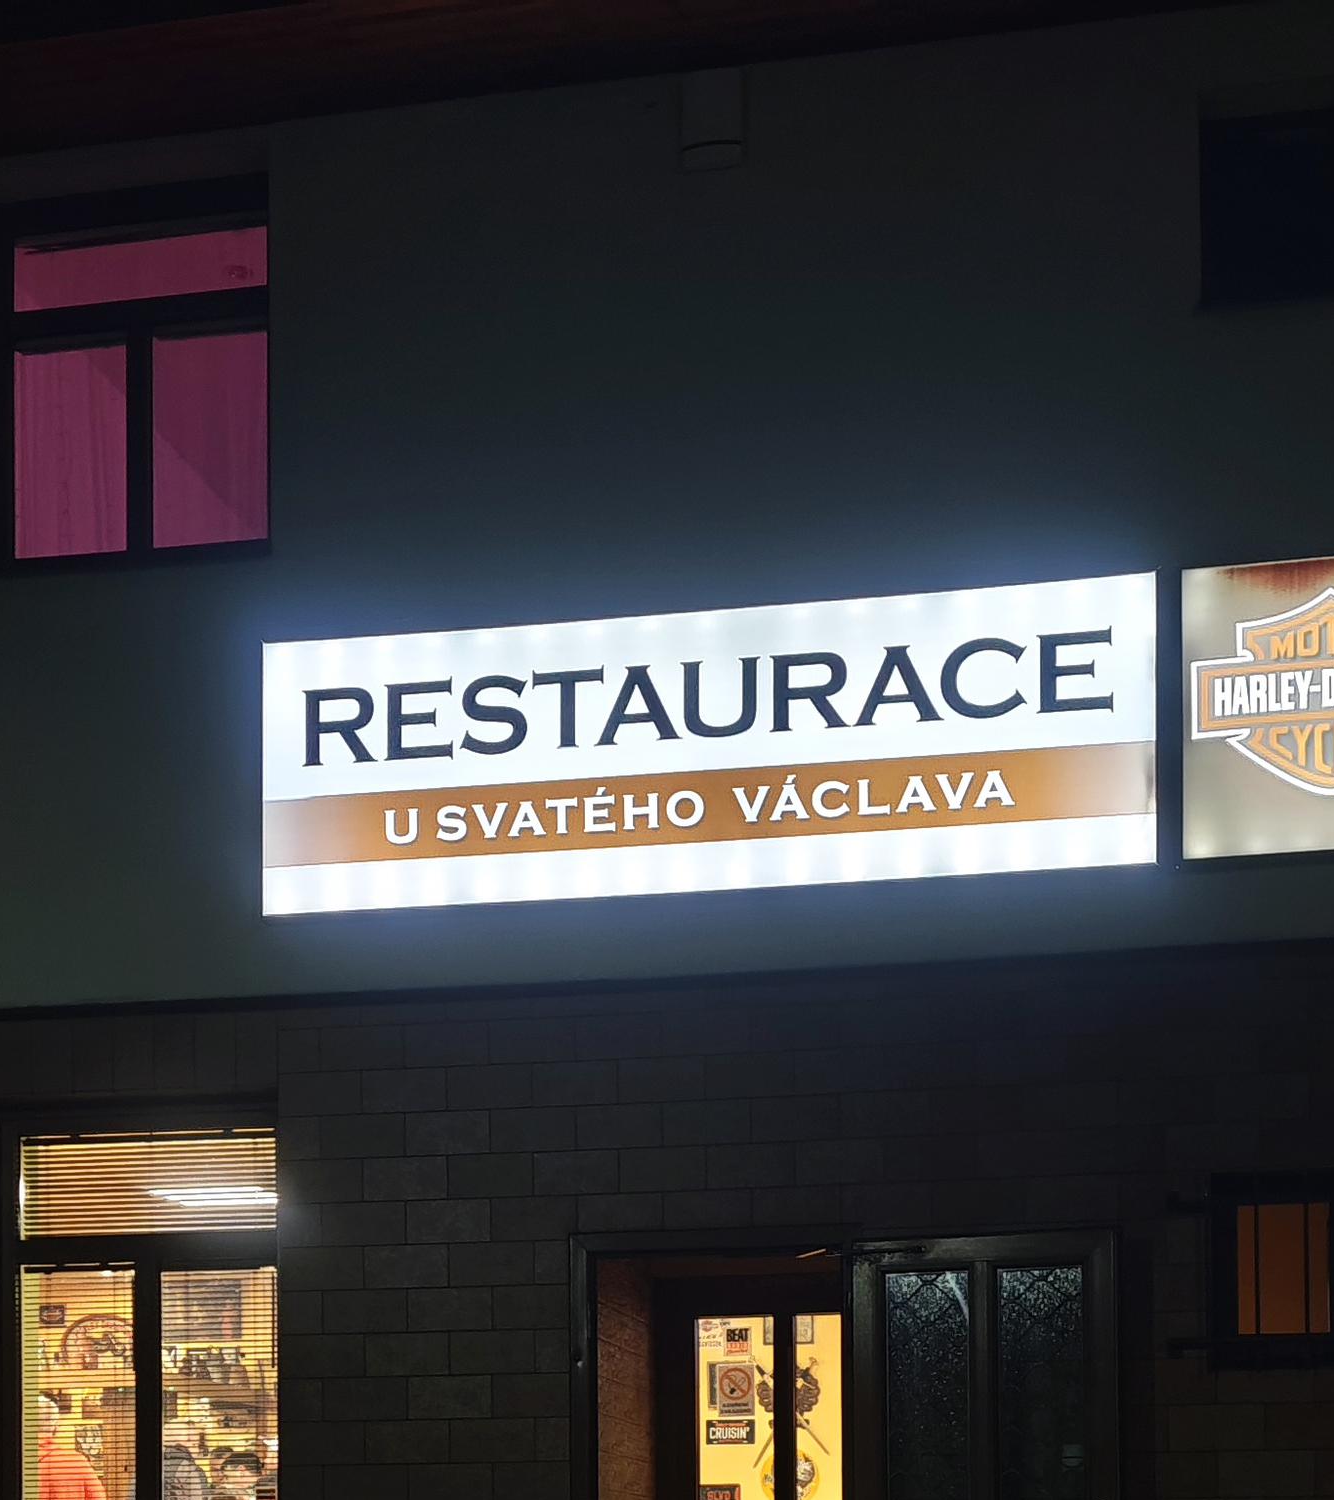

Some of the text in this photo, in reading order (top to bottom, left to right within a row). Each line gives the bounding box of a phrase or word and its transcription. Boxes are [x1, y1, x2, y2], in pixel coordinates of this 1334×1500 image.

[302, 625, 1114, 767] RESTAURACE
[383, 769, 1016, 846] U SVATÉHO VÁCLAVA
[726, 1327, 750, 1342] BEAT
[709, 1426, 750, 1440] CRUISIN'
